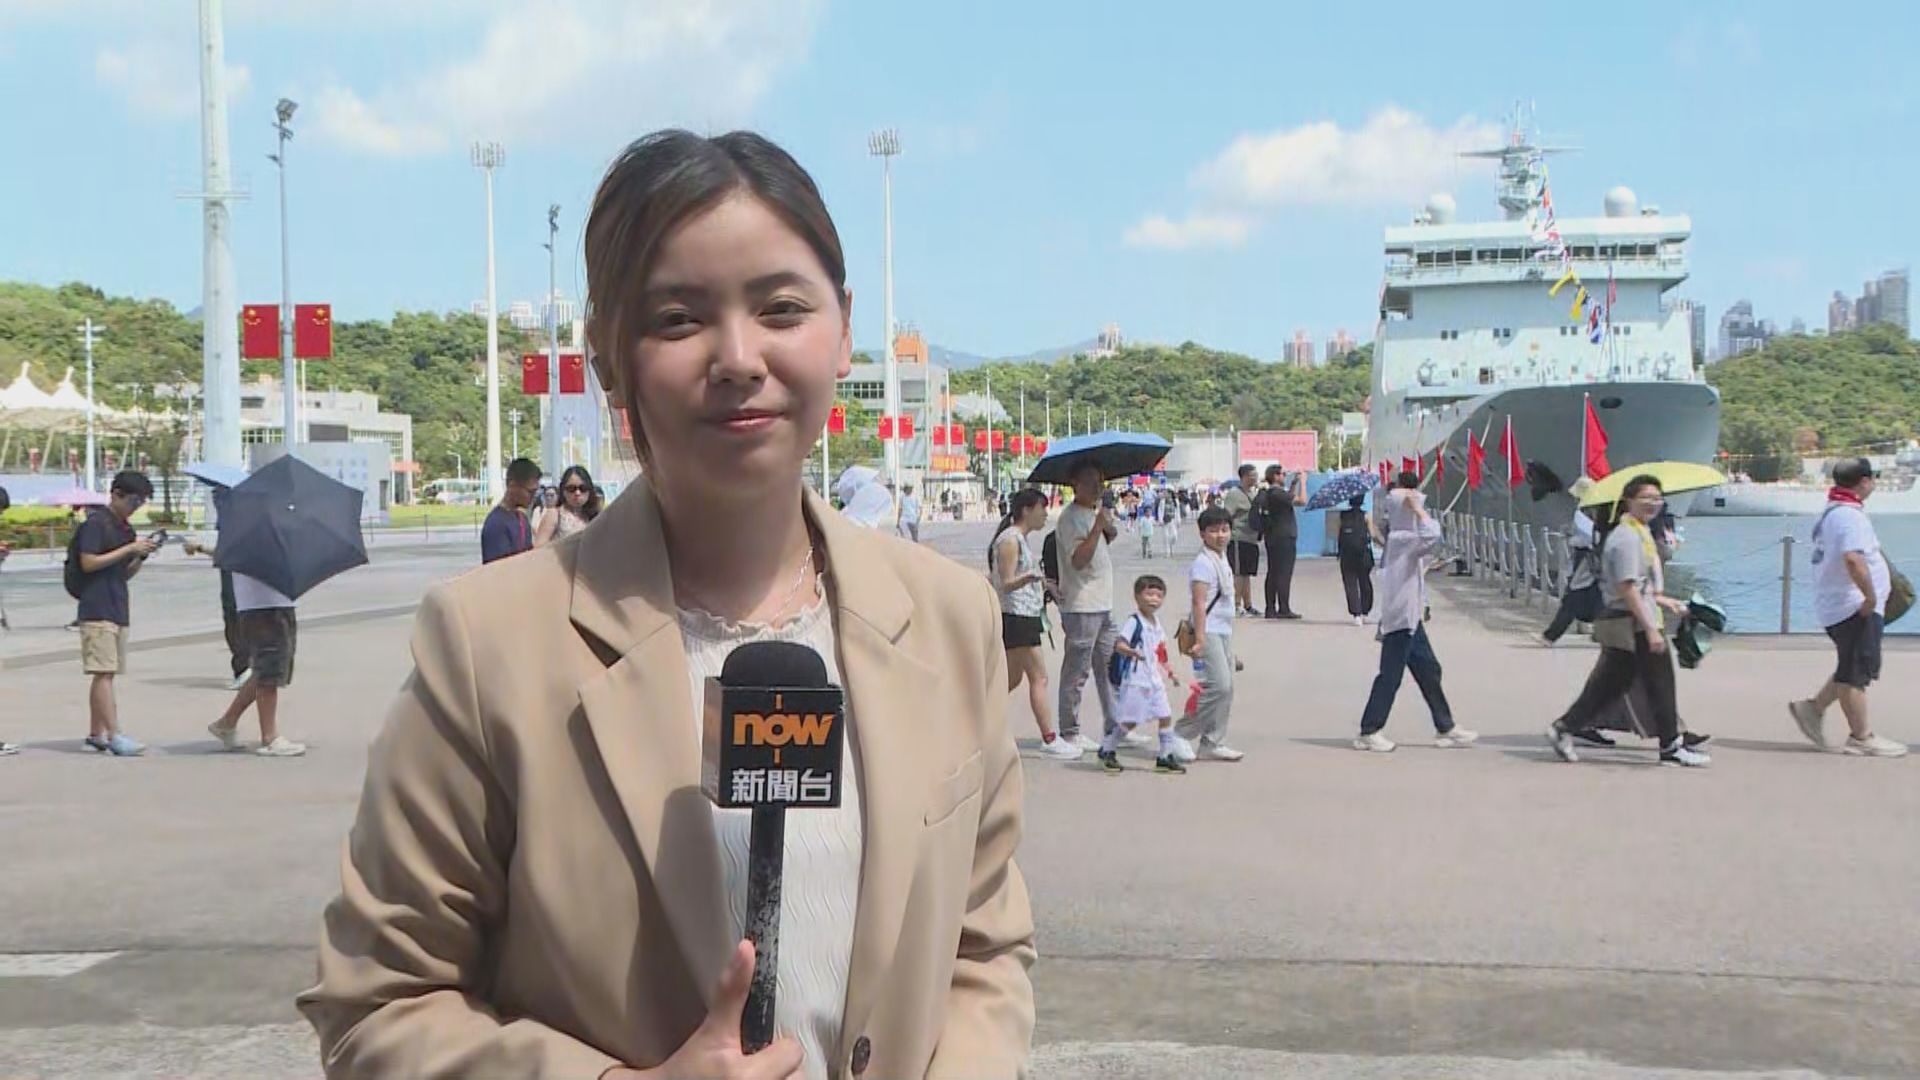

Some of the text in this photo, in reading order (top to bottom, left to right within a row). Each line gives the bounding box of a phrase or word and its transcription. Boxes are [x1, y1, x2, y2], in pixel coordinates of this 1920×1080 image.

[732, 713, 836, 746] now
[731, 768, 833, 803] 新聞台
